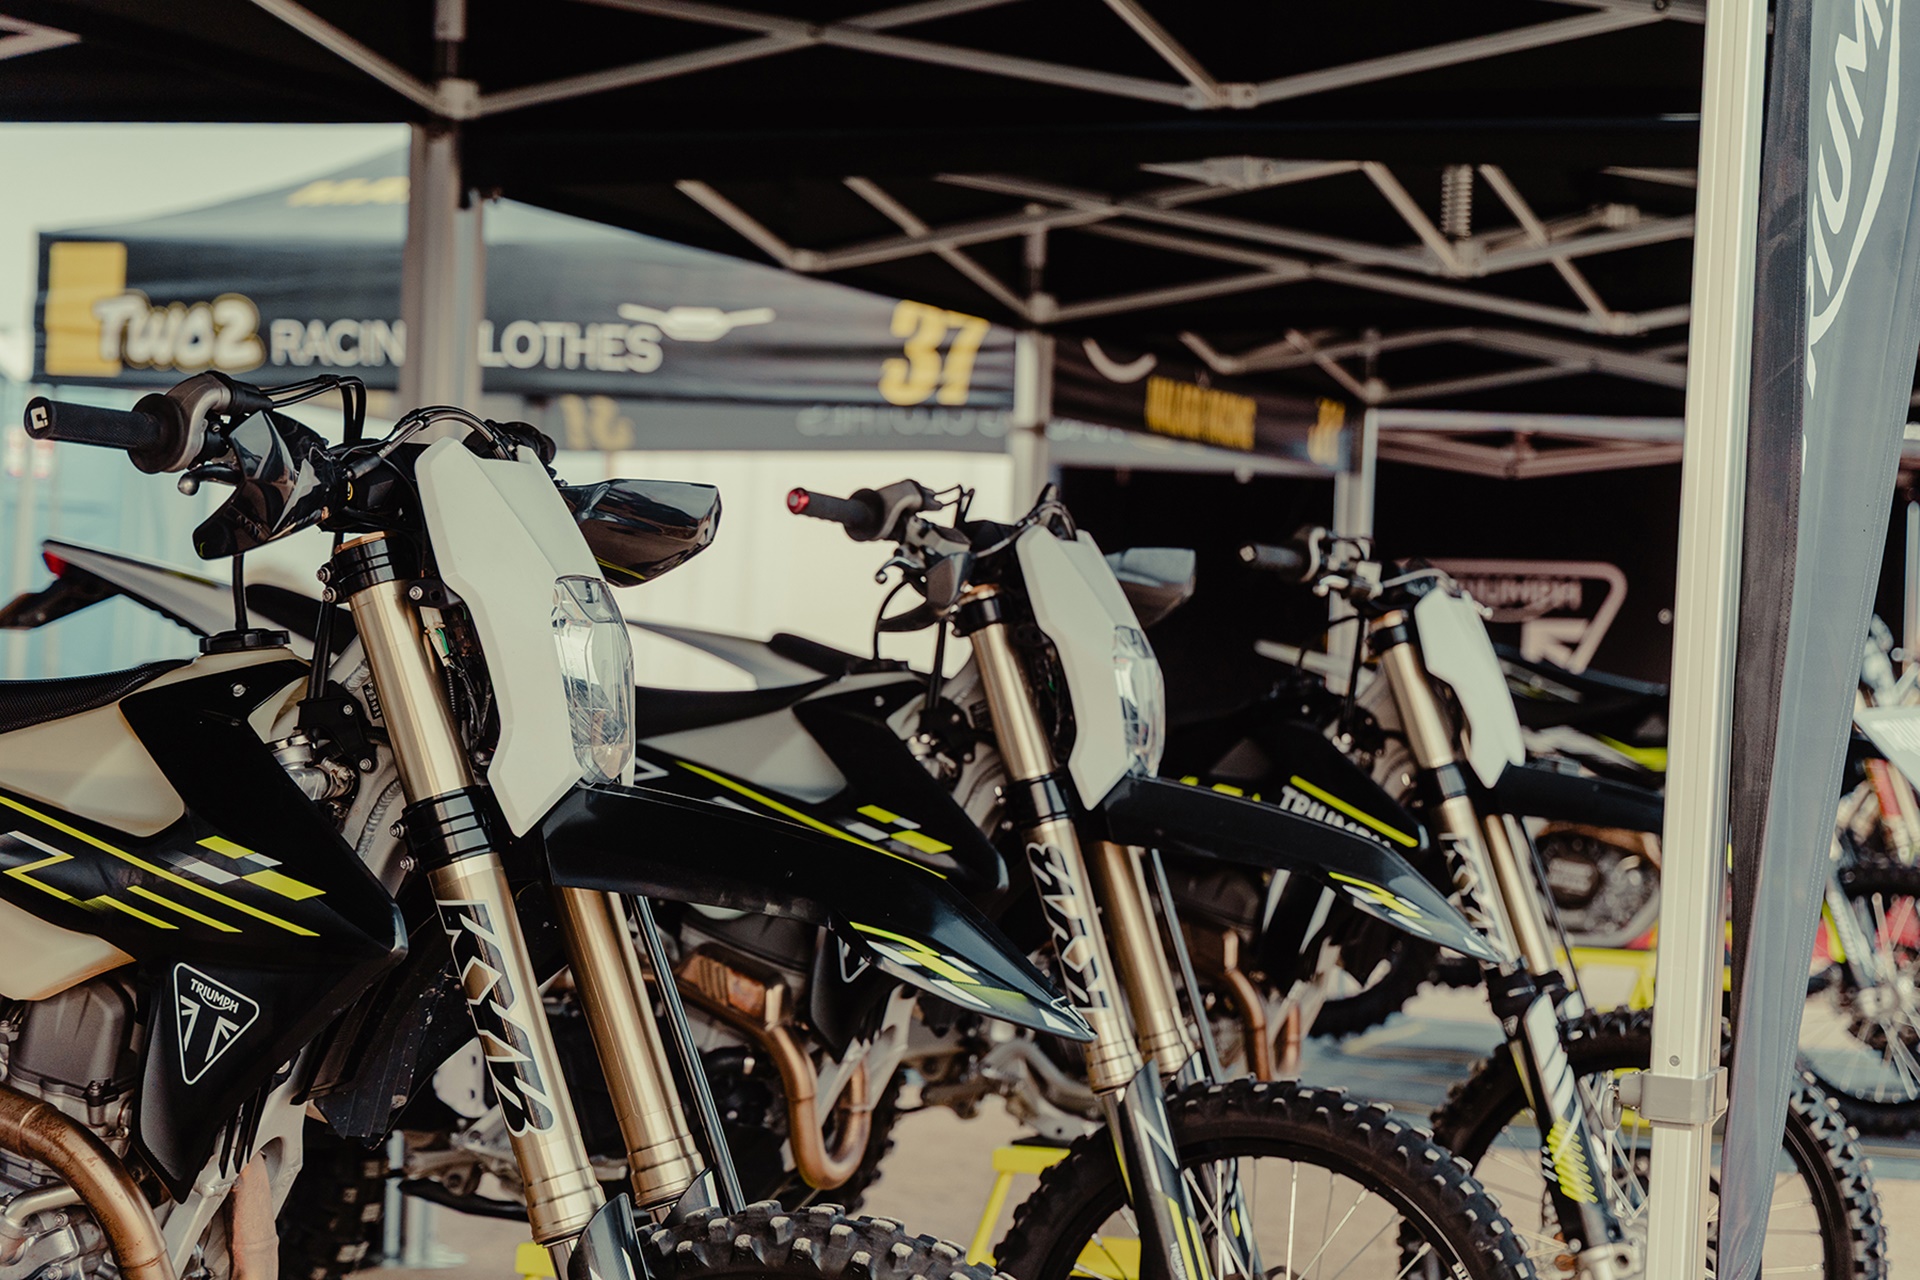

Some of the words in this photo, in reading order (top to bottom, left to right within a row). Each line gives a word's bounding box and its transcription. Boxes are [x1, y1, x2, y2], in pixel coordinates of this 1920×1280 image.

[270, 318, 407, 367] RACIN
[478, 319, 664, 373] LOTHES
[878, 299, 990, 405] 37
[190, 978, 240, 1014] TRIUMPH
[437, 899, 557, 1138] KYB
